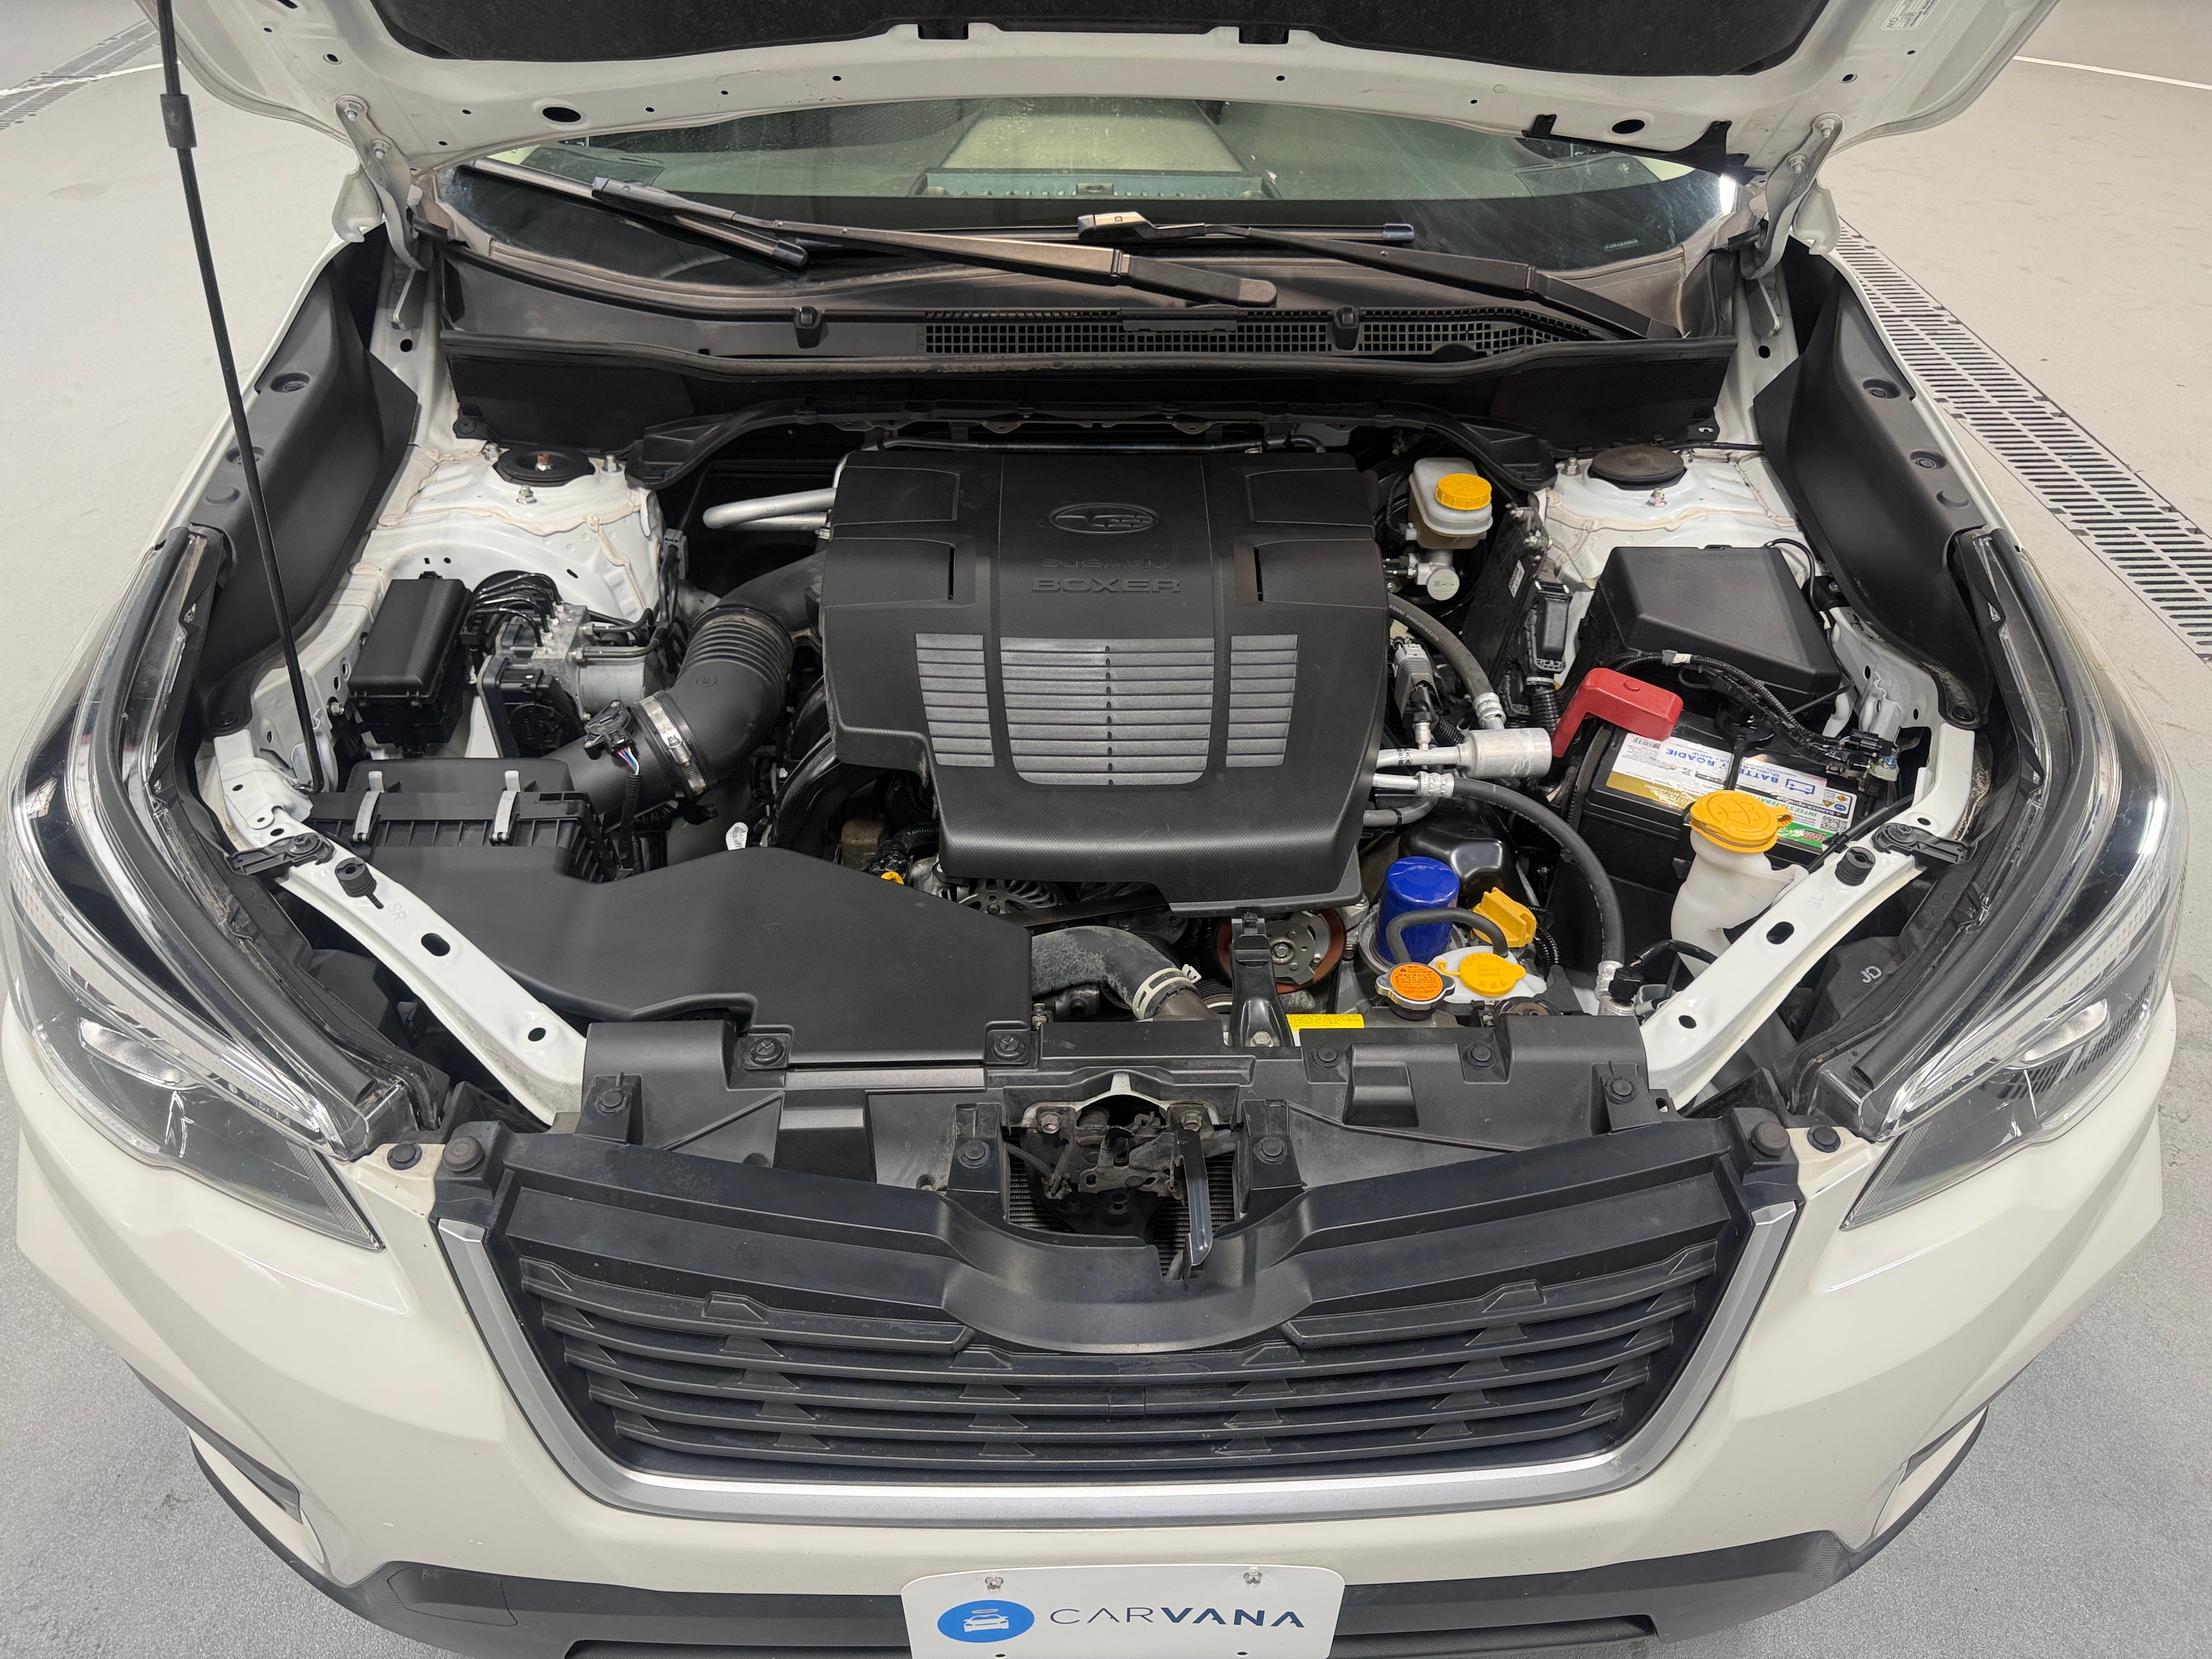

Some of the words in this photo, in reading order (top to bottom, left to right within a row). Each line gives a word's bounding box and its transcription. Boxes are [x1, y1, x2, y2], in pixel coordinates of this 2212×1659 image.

[1039, 557, 1172, 569] SUBARU
[1031, 577, 1181, 594] BOXER
[1666, 748, 1716, 767] ROADIE
[1718, 763, 1779, 783] BATTEY
[1807, 894, 1825, 909] SL
[387, 902, 407, 922] SR
[1049, 1607, 1305, 1628] CARVANA
